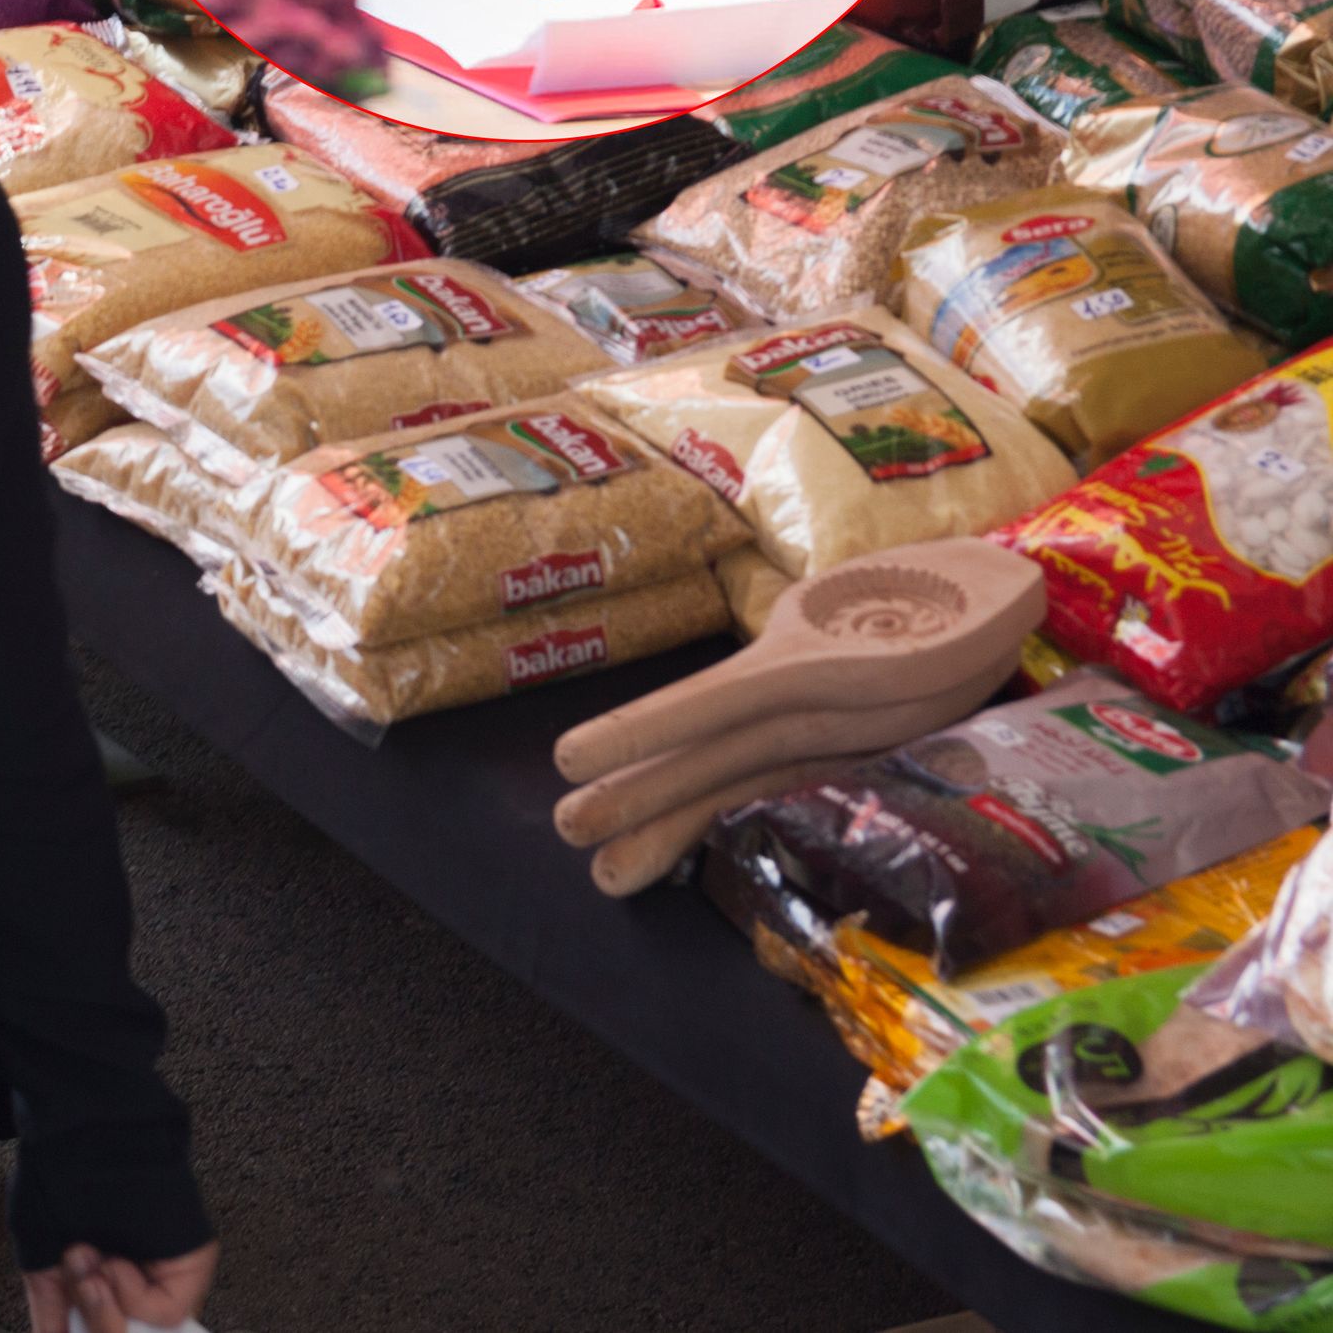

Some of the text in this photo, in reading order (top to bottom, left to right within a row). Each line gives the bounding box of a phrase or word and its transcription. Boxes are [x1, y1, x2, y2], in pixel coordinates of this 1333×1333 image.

[139, 165, 271, 246] Baharoğlu
[413, 273, 493, 334] bakan
[737, 326, 865, 370] bakan
[528, 413, 608, 474] bakan
[673, 430, 744, 502] bakan
[503, 561, 603, 604] bakan
[508, 636, 606, 682] bakan
